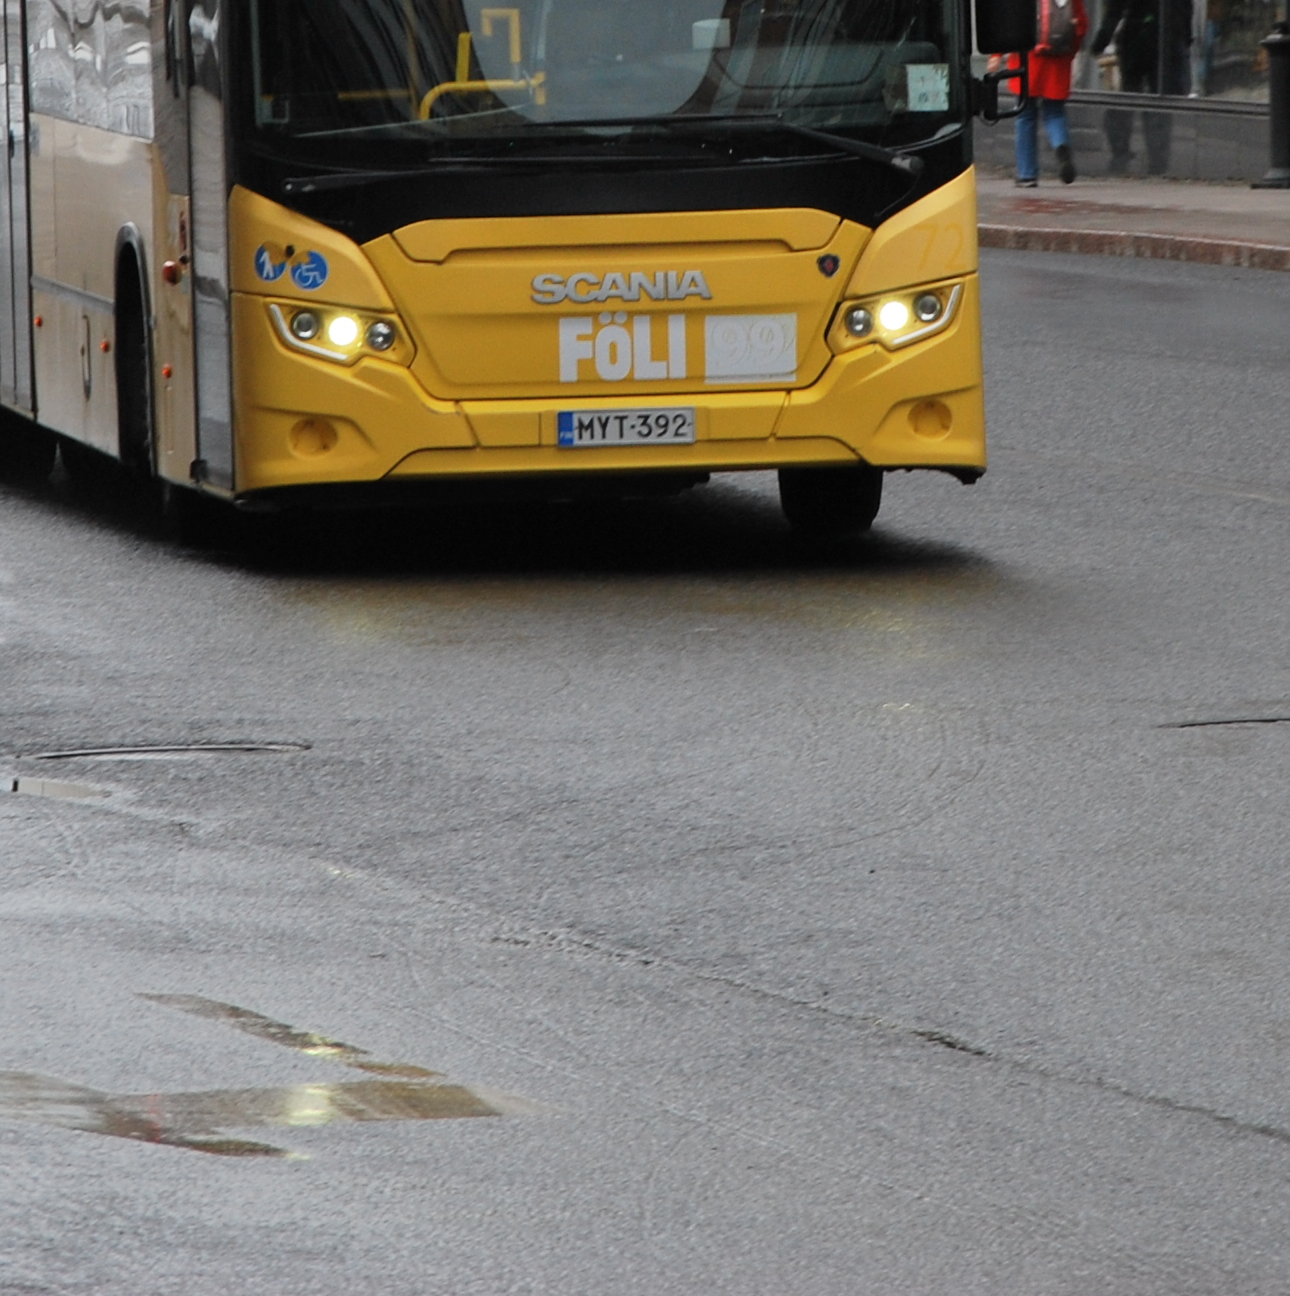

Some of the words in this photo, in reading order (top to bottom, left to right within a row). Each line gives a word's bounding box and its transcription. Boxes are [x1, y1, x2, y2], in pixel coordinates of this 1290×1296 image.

[531, 270, 713, 304] SCANIA
[559, 310, 687, 383] FÖLI
[577, 413, 688, 441] MYT-392
